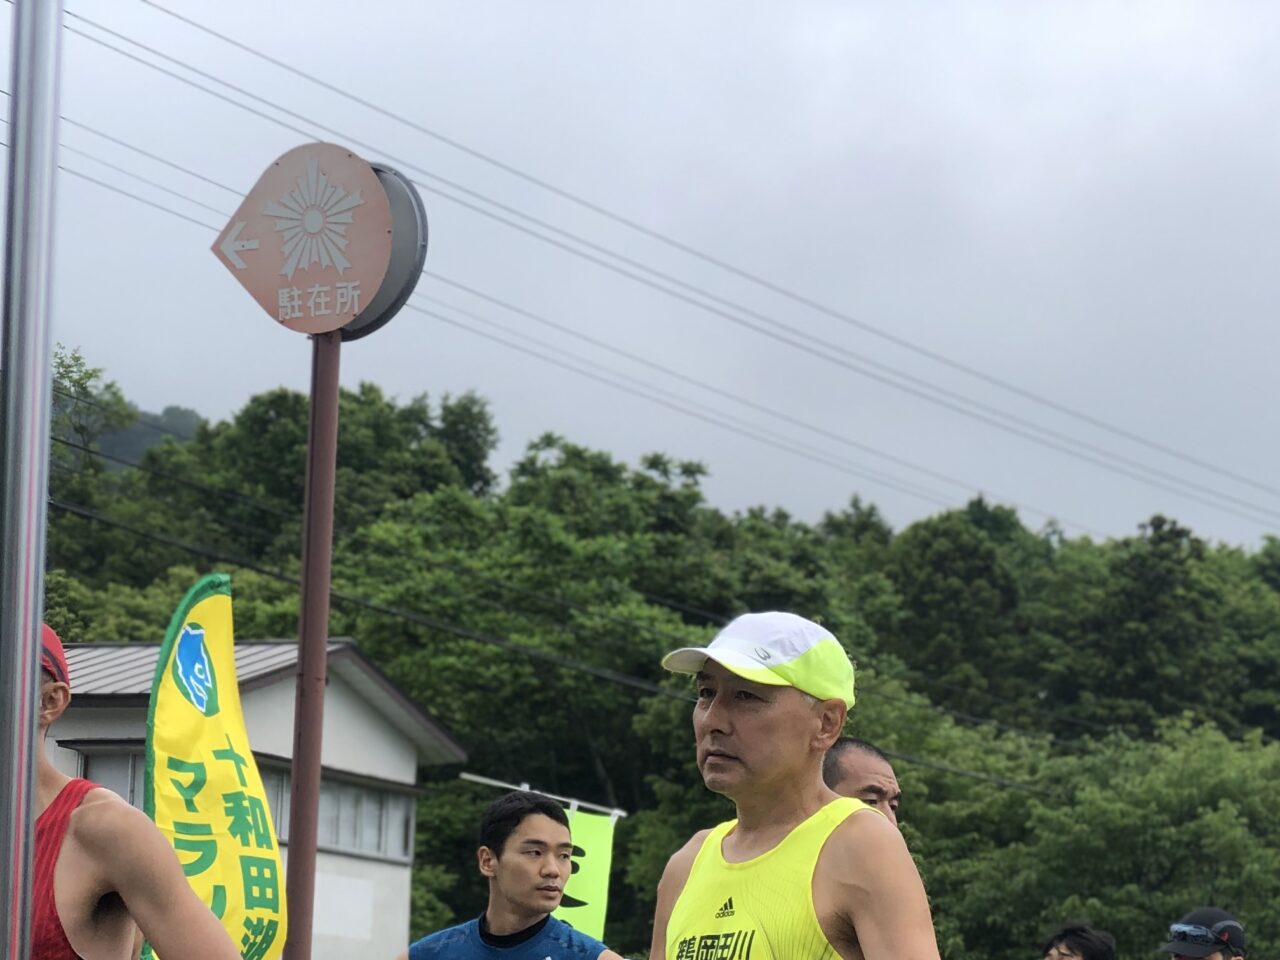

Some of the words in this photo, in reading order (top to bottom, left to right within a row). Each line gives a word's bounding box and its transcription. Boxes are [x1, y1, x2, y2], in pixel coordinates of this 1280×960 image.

[278, 280, 361, 321] 駐在所
[714, 910, 735, 919] adidas
